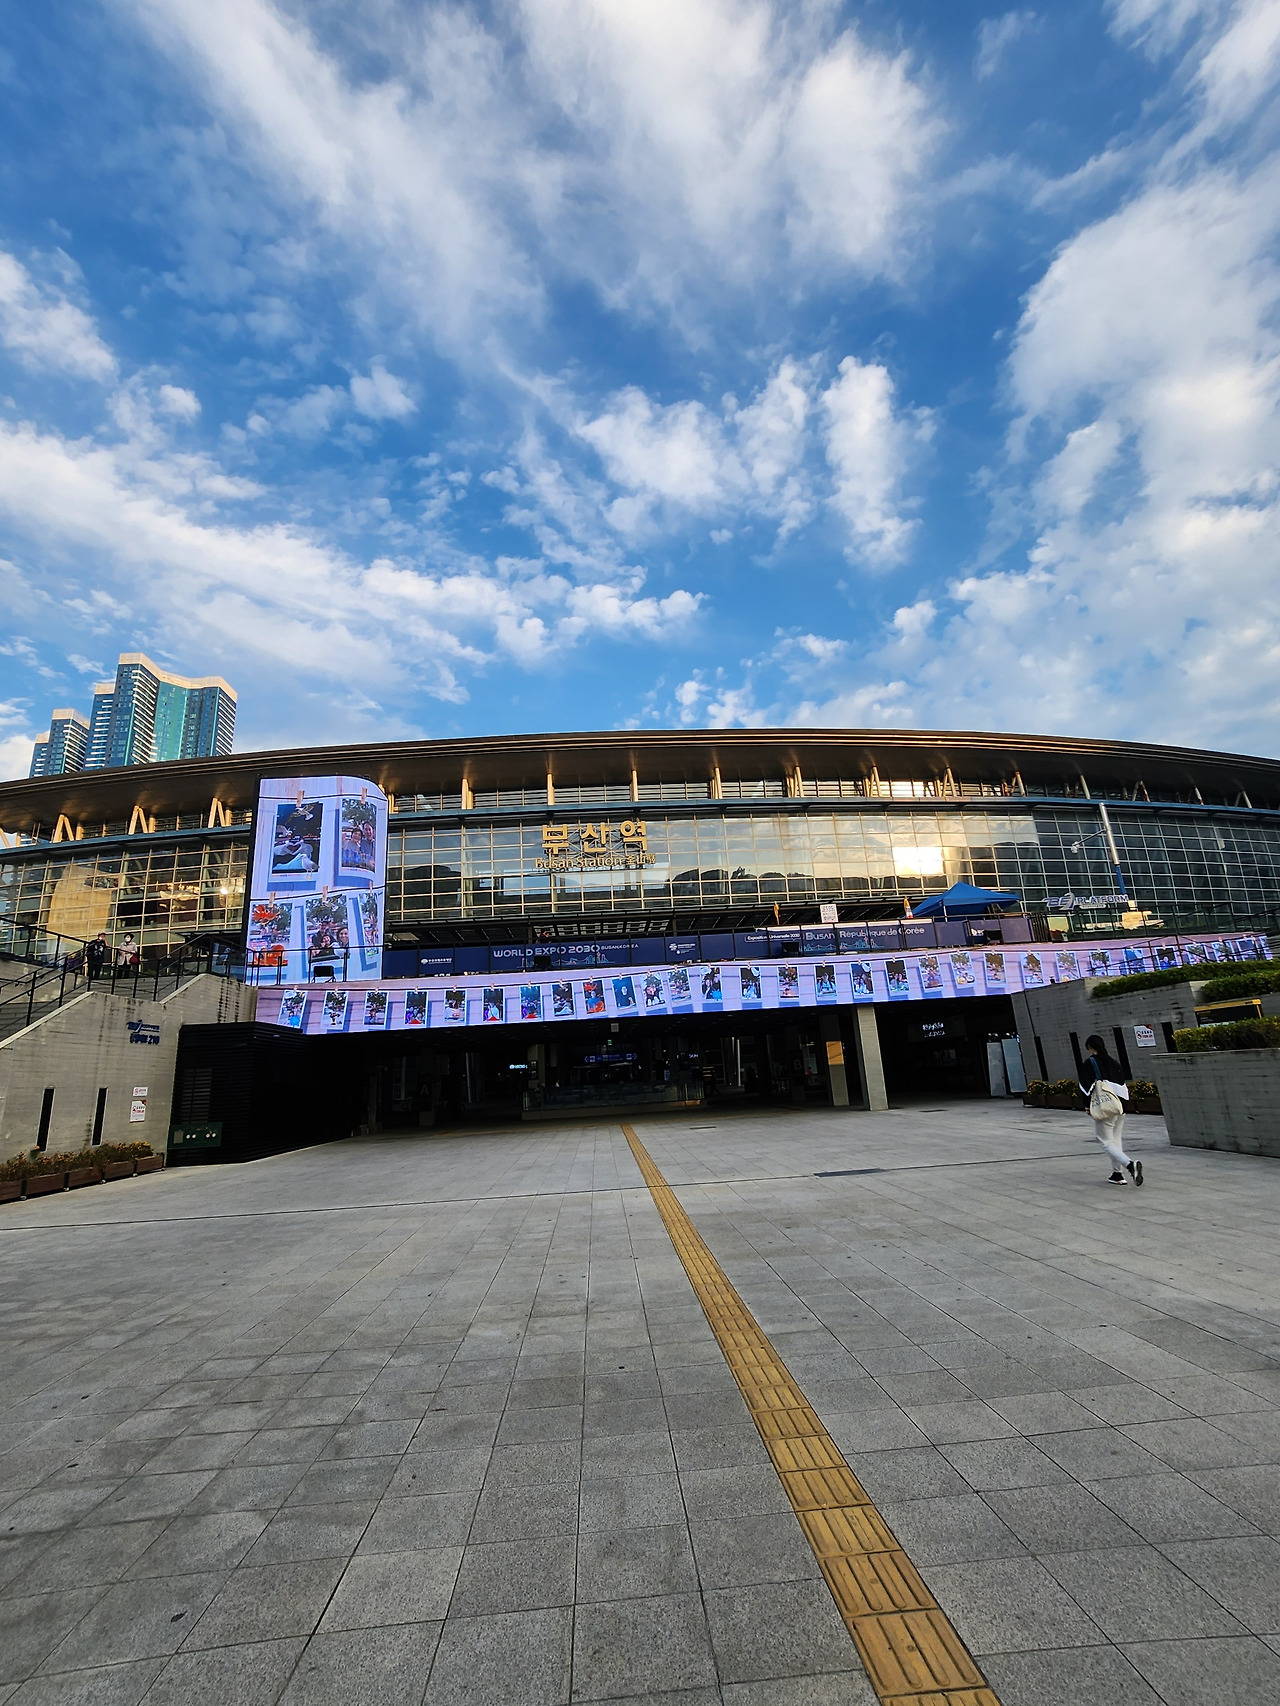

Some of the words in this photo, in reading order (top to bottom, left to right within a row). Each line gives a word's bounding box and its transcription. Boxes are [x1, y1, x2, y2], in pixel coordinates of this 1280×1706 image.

[541, 820, 648, 854] 부산역
[535, 856, 574, 869] Busan
[576, 854, 622, 868] Station
[1076, 895, 1129, 905] PLATFORM
[887, 927, 898, 936] de
[493, 948, 534, 958] WORLD
[534, 946, 567, 956] EXPO
[568, 944, 600, 954] 2030
